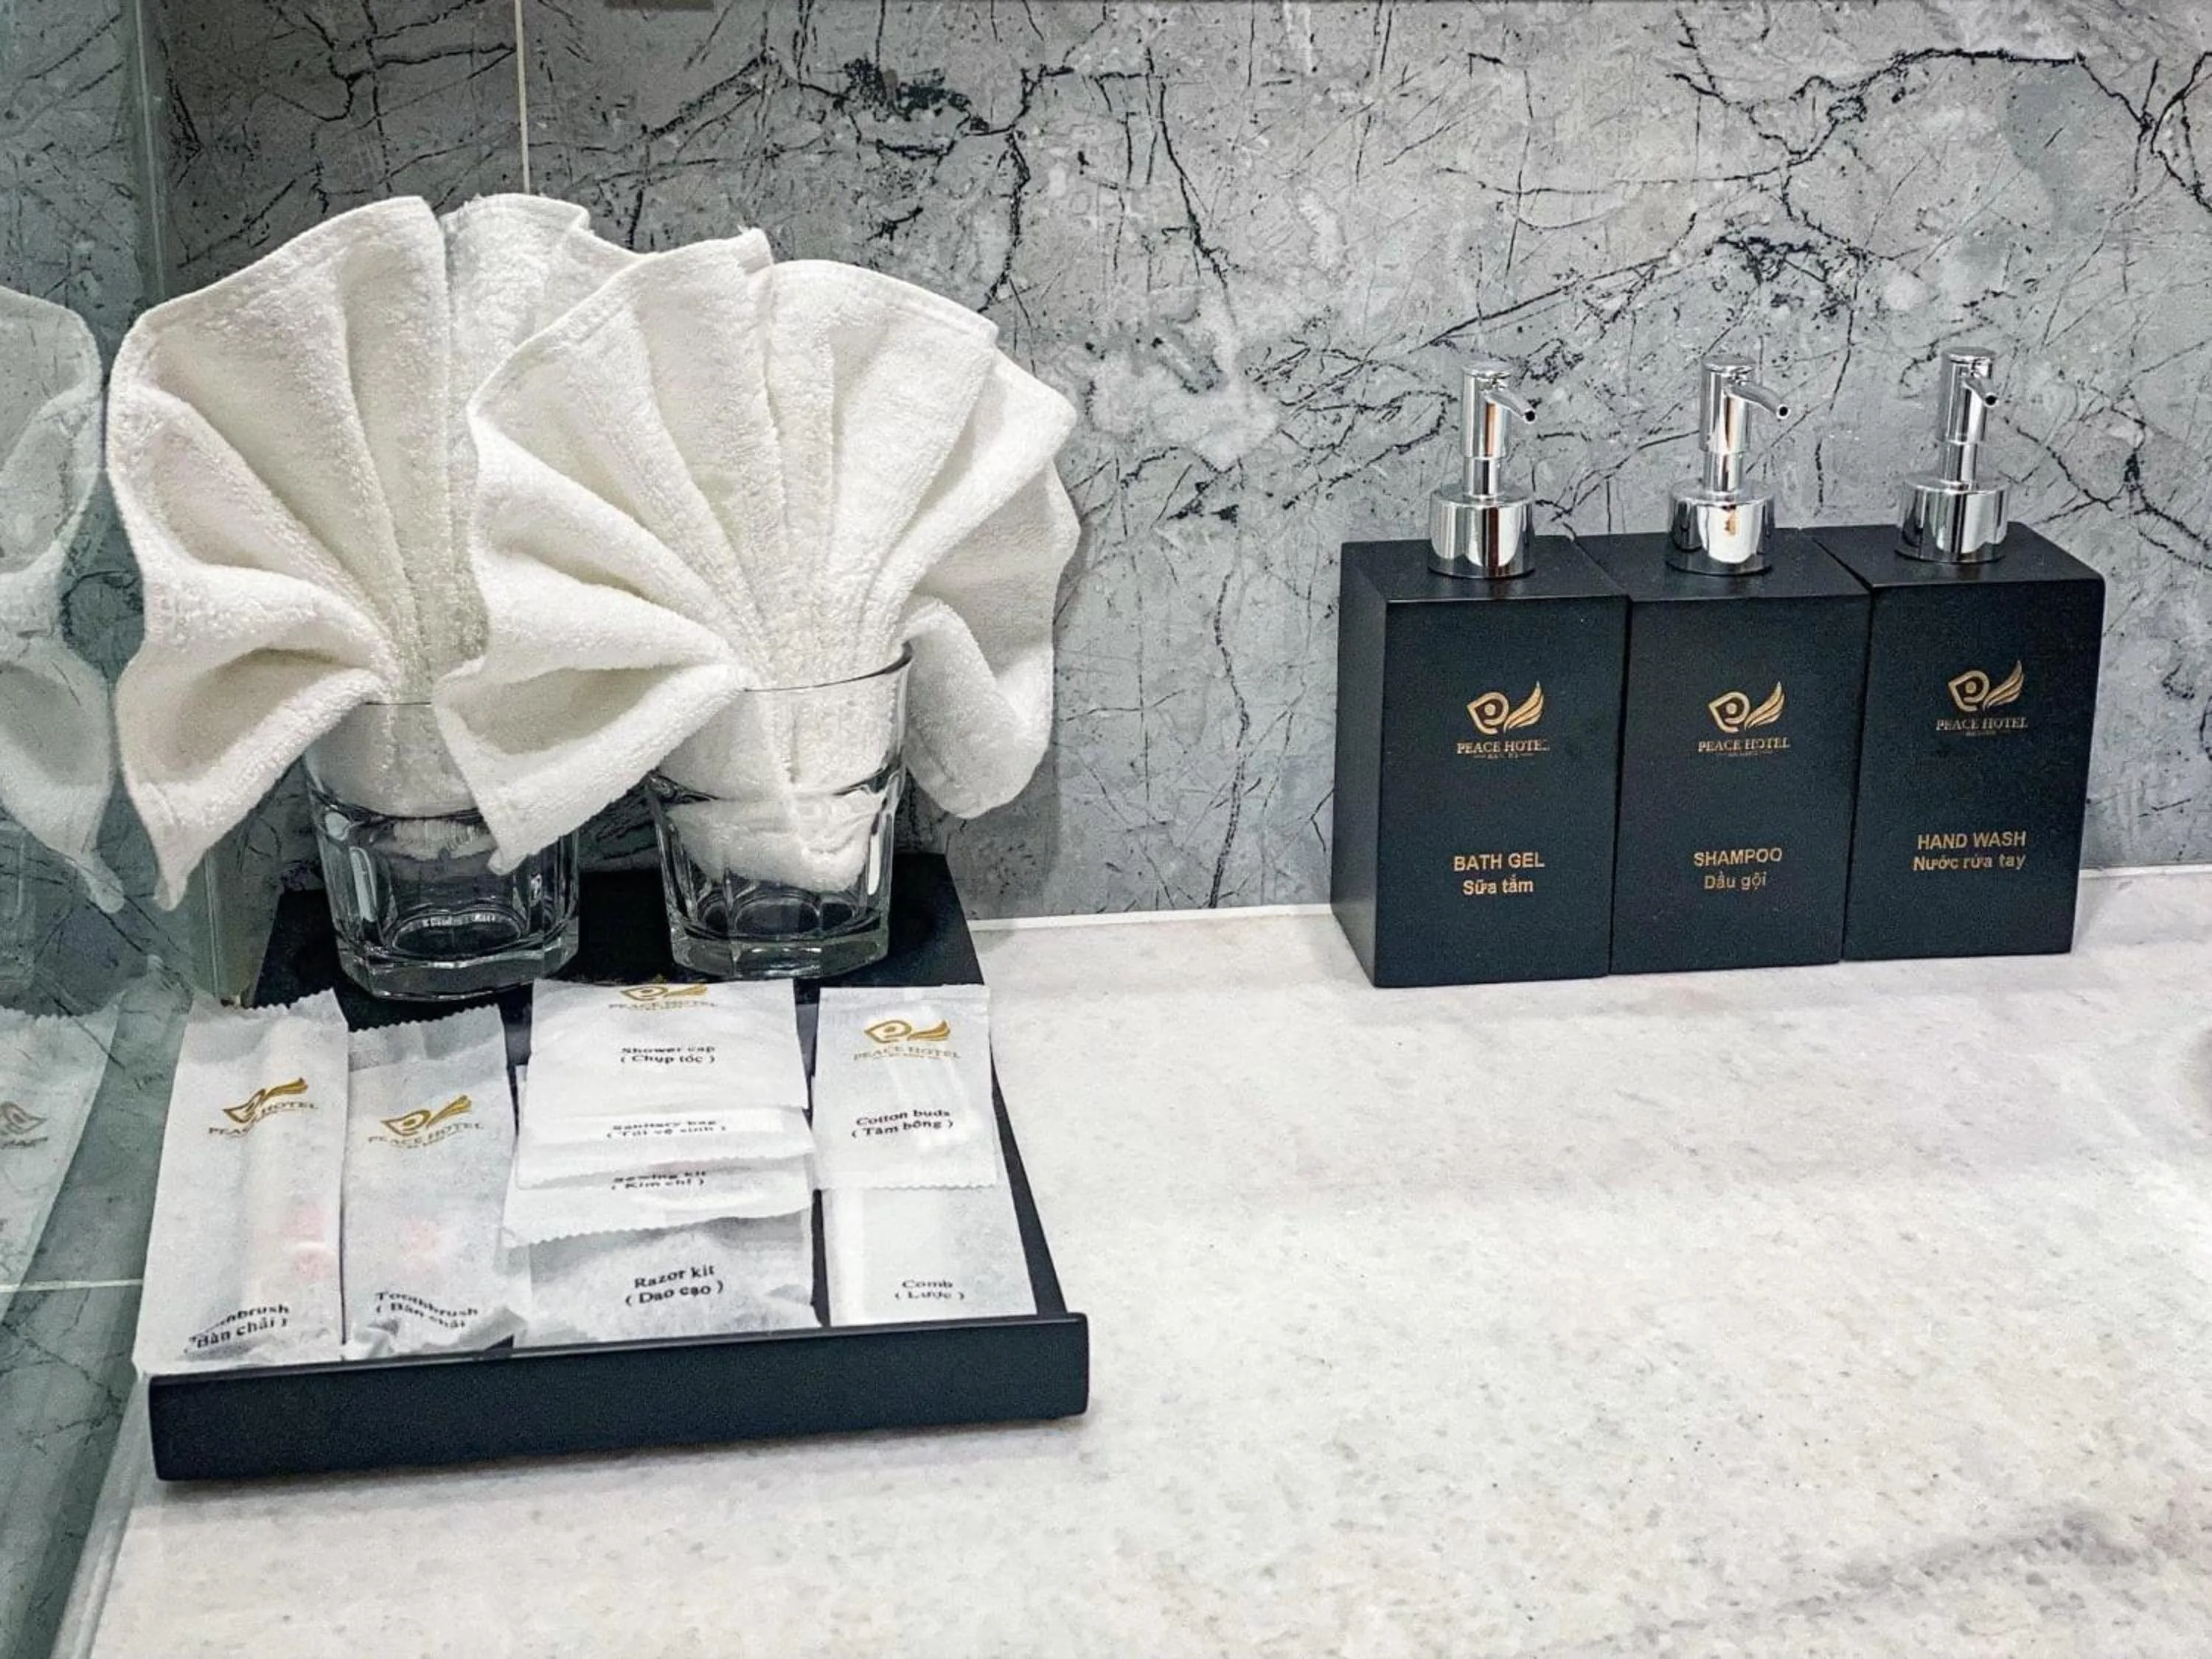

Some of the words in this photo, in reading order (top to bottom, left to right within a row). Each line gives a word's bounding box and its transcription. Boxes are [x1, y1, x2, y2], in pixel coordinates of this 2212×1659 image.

[1935, 719, 1979, 731] PEACE
[1982, 717, 2028, 729] HOTEL
[1456, 741, 1501, 754] PEACE
[1698, 739, 1741, 752] PEACE
[1745, 737, 1791, 750] HOTEL
[1918, 832, 1968, 849] HAND
[1973, 830, 2027, 848] WASH
[1454, 853, 1503, 871] BATH
[1508, 852, 1545, 869] GEL
[1694, 847, 1782, 866] SHAMPOO
[1912, 855, 1959, 871] Nước
[1963, 854, 1993, 869] rửa
[1999, 853, 2027, 870] tay
[1463, 878, 1498, 896] Sữa
[1502, 873, 1534, 894] tắm
[1704, 870, 1736, 890] Dầu
[1741, 871, 1767, 891] gội
[688, 1046, 716, 1054] cap
[853, 1046, 904, 1060] PEACE
[908, 1046, 961, 1059] HOTEL
[632, 1054, 675, 1064] Chụp
[856, 1112, 908, 1126] Cotton
[913, 1109, 950, 1117] buds
[903, 1119, 942, 1130] bông
[634, 1270, 686, 1289] Razor
[690, 1265, 715, 1278] kit
[902, 1279, 953, 1288] Comb
[639, 1290, 675, 1304] Dao
[679, 1285, 712, 1297] cạo
